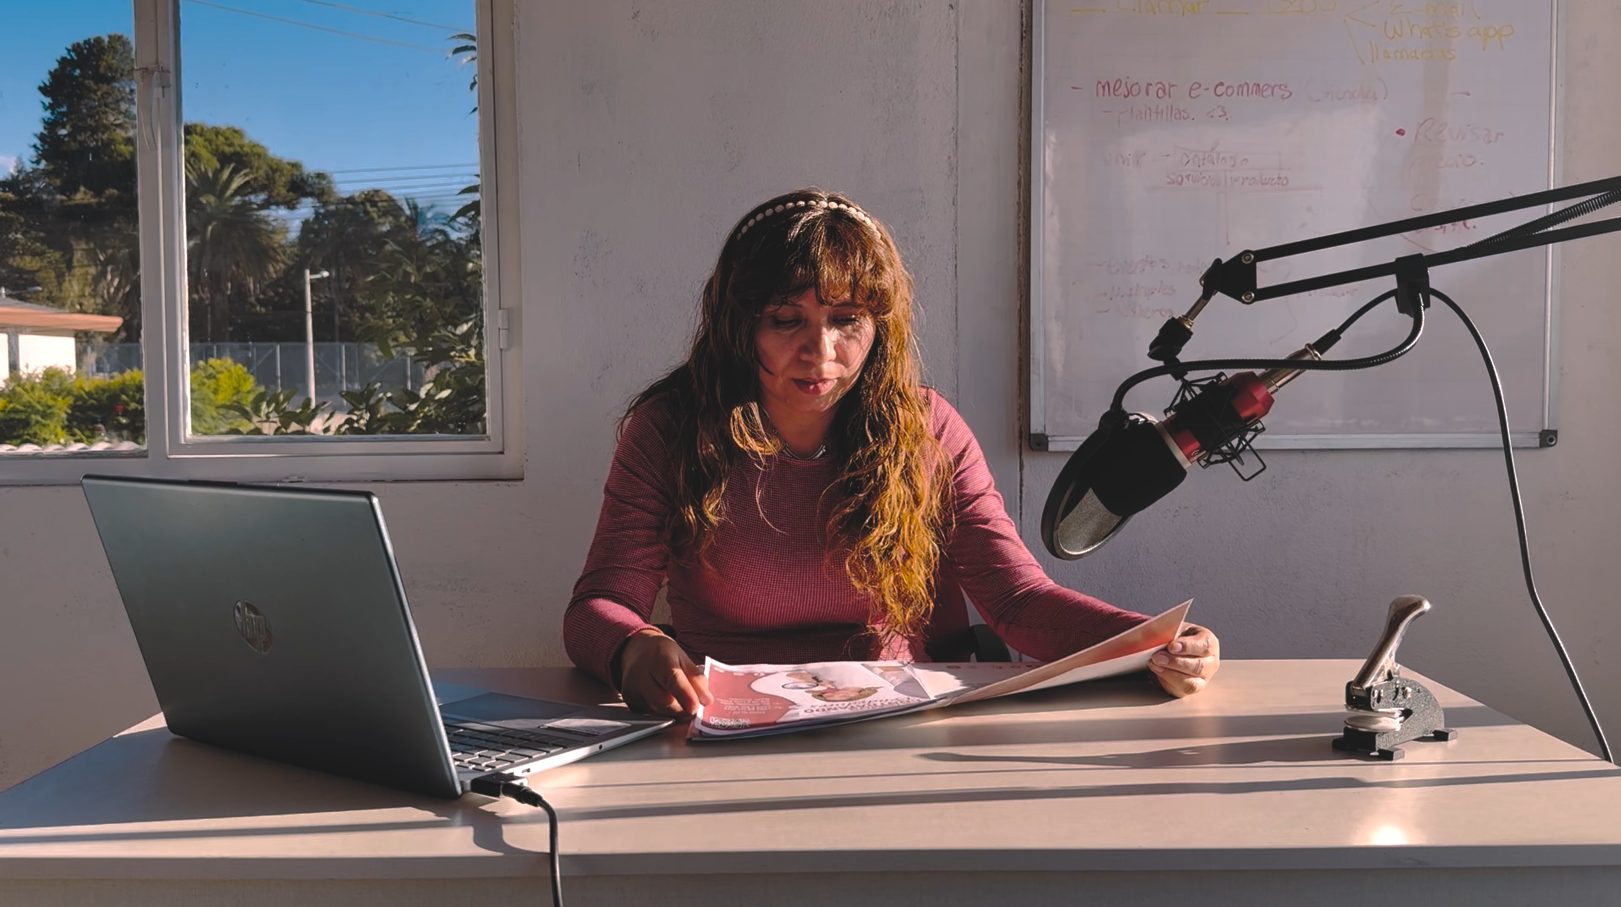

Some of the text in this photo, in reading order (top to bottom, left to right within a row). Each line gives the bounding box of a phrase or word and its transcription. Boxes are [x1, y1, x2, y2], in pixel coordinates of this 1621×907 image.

[1468, 23, 1516, 50] app
[1095, 76, 1177, 99] mejorar
[1188, 80, 1293, 100] e-commers
